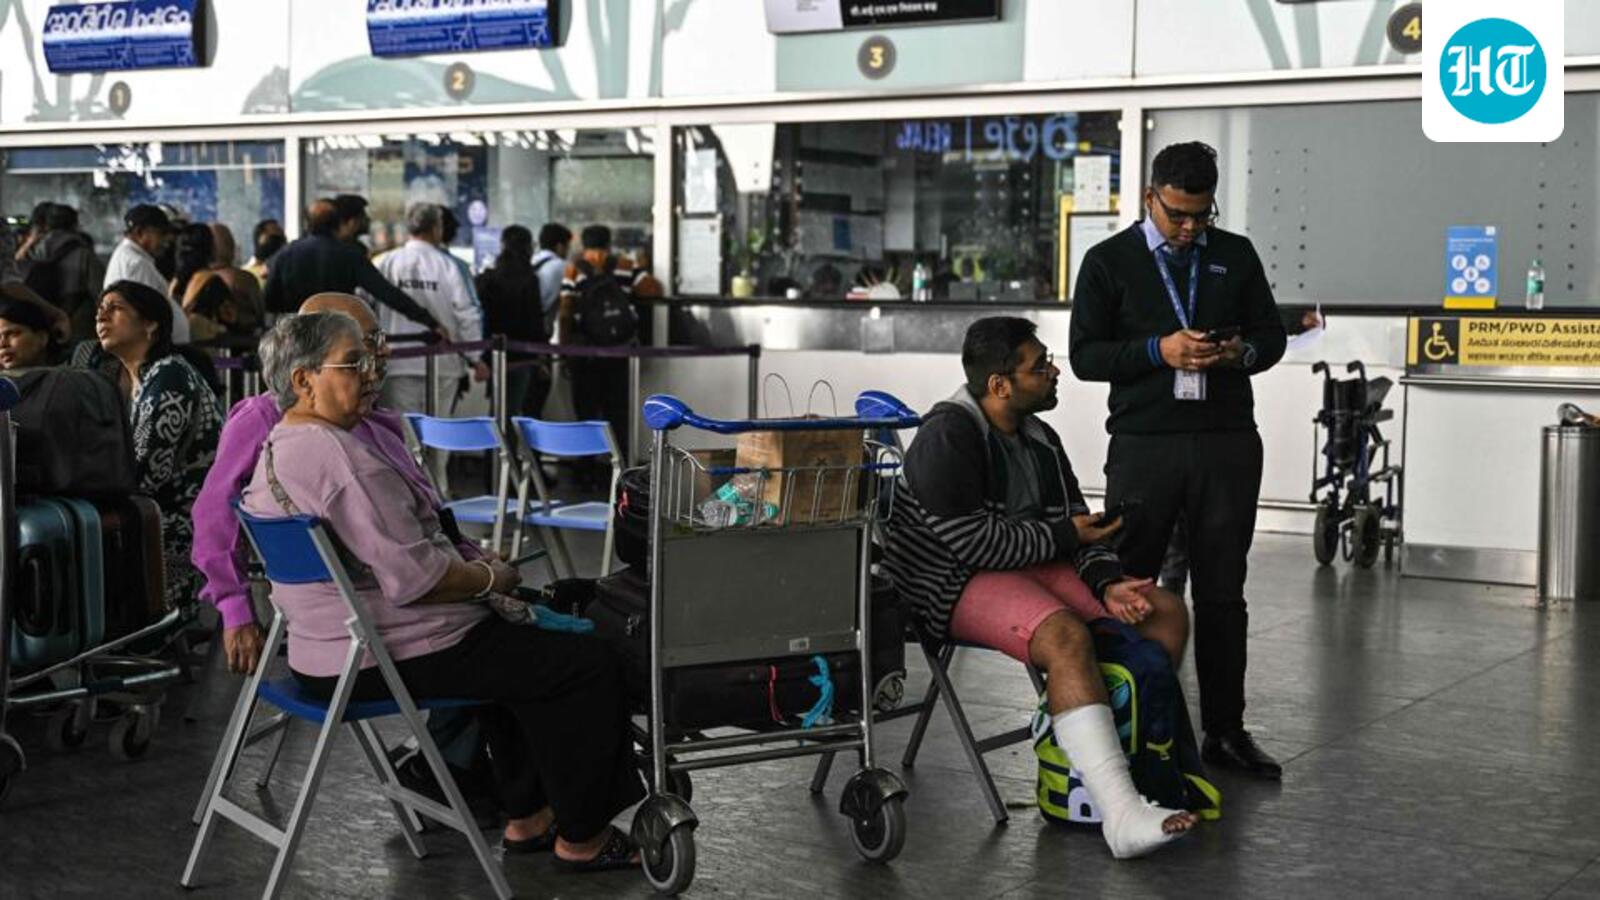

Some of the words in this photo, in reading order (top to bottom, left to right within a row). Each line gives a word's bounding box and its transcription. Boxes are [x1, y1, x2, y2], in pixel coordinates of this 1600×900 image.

[1403, 17, 1421, 40] 4
[868, 45, 885, 69] 3
[453, 71, 466, 90] 2
[1467, 321, 1547, 335] PRM/PWD
